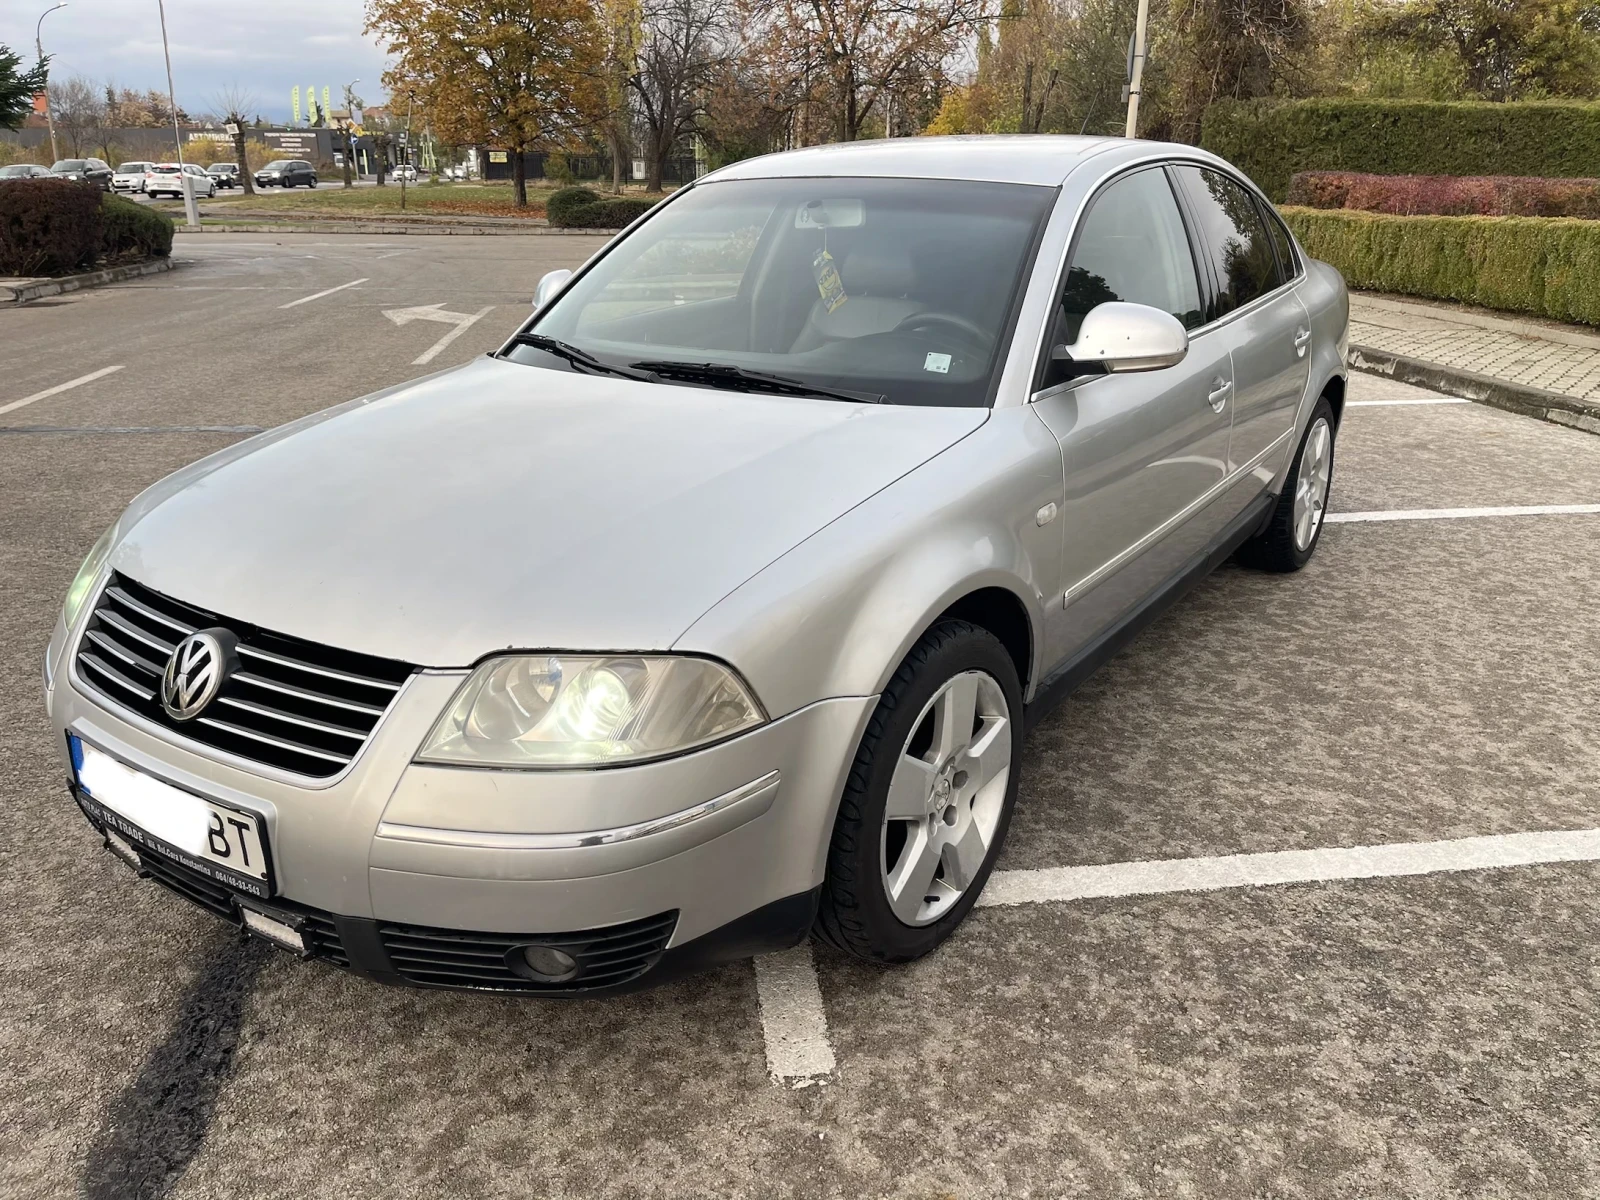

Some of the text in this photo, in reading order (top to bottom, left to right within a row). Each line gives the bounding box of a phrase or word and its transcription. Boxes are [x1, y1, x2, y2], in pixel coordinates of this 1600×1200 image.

[102, 810, 118, 828] TEA
[117, 820, 144, 843] TRADE
[208, 810, 251, 867] BT
